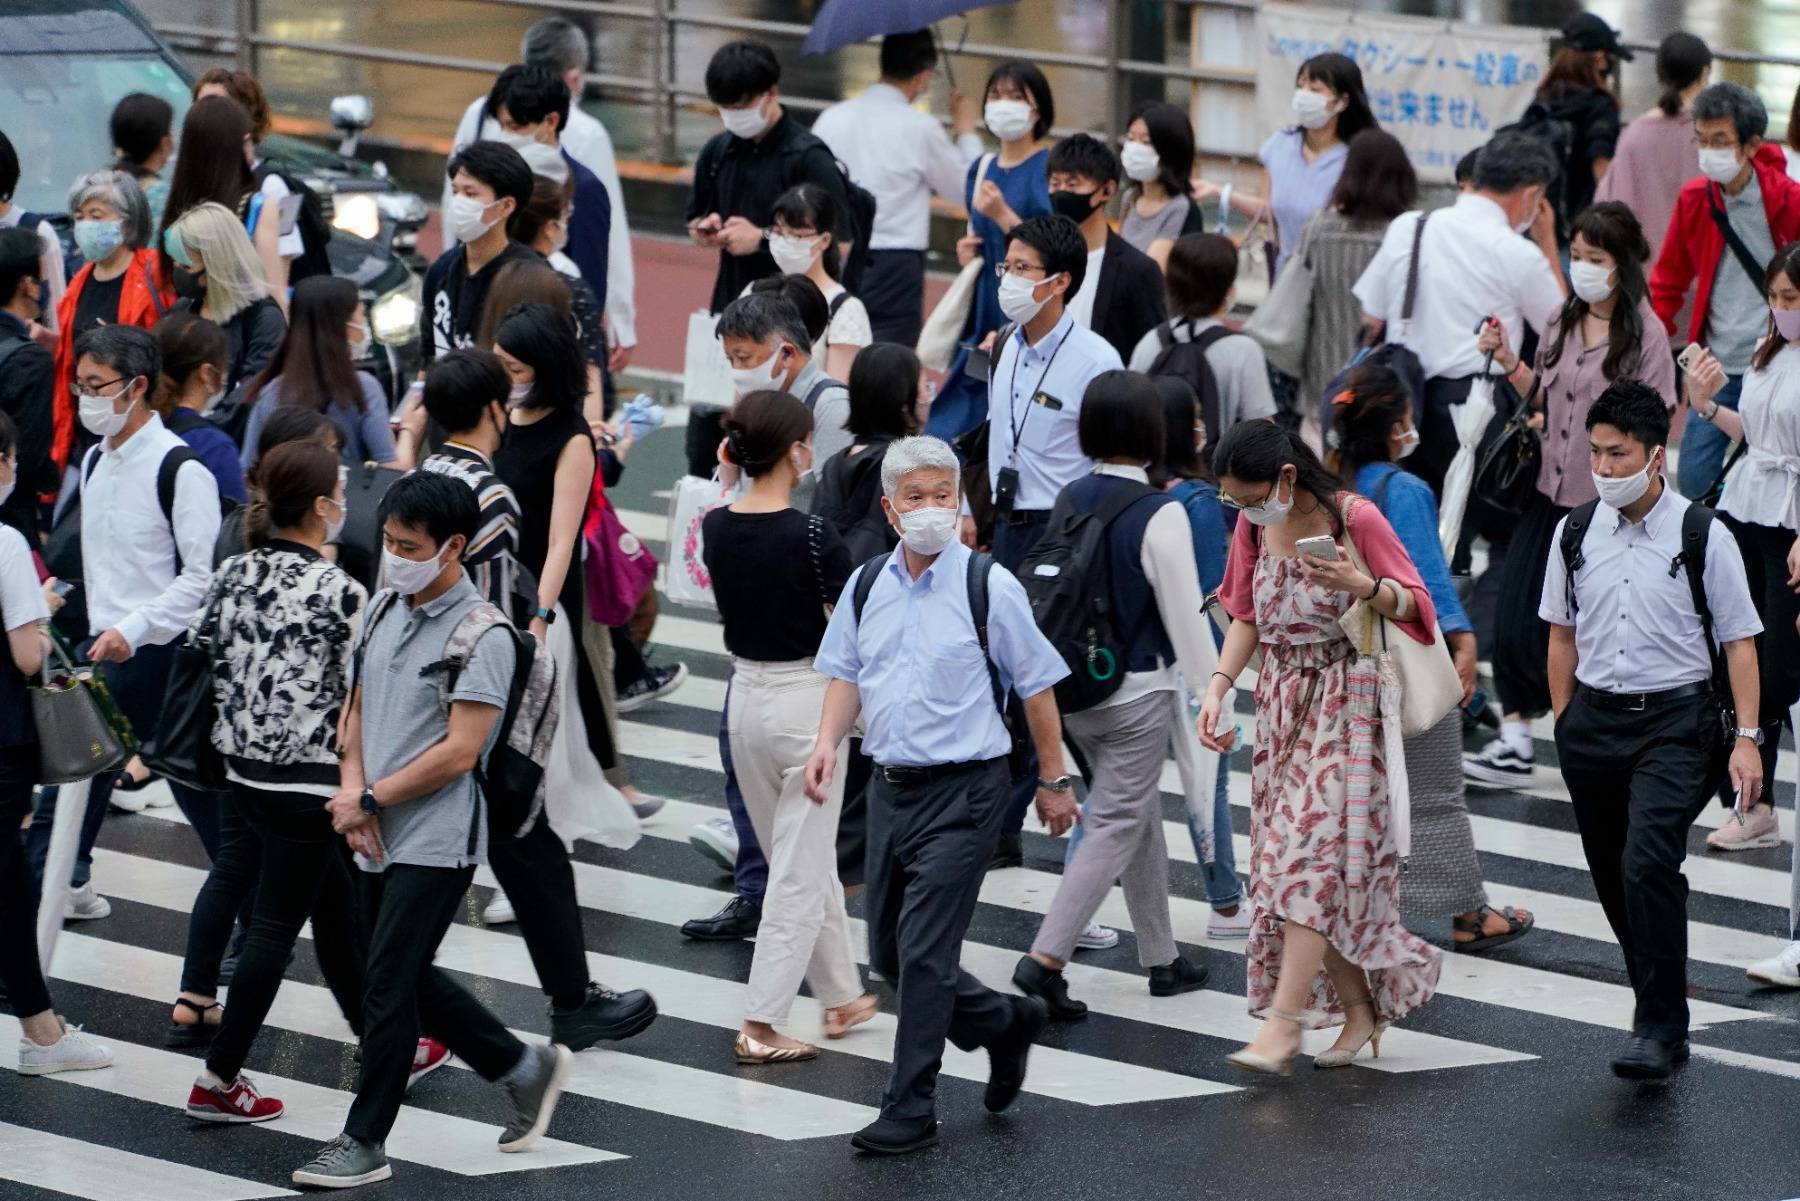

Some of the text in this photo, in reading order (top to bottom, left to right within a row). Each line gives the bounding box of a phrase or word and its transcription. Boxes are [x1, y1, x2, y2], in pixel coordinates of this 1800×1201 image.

[1366, 89, 1488, 131] 出来ません
[234, 1091, 256, 1113] N
